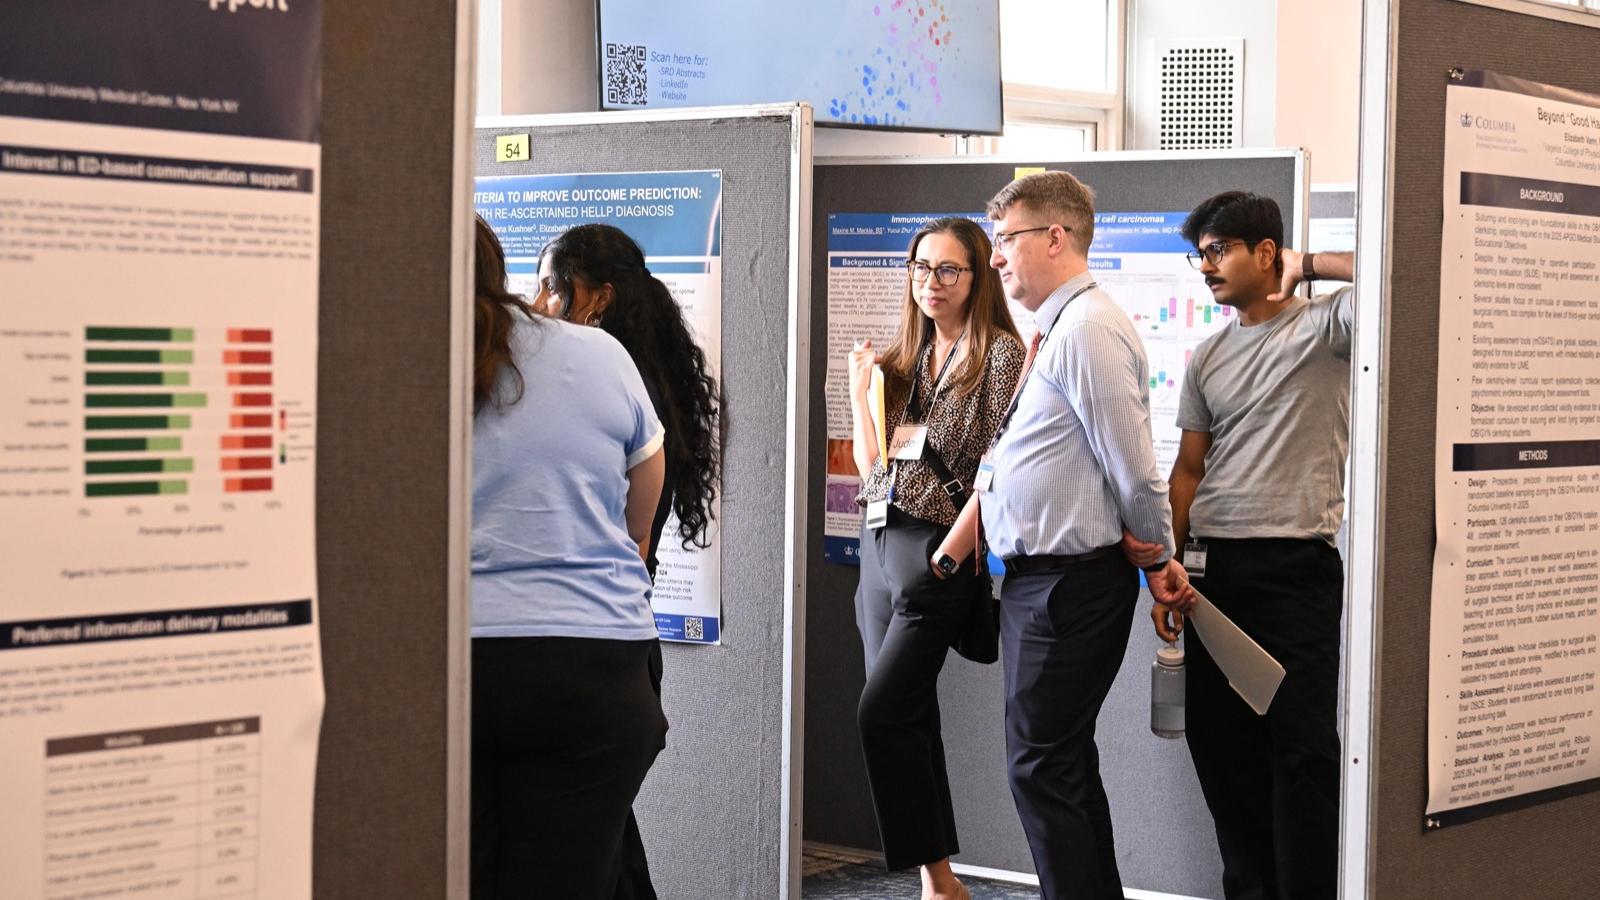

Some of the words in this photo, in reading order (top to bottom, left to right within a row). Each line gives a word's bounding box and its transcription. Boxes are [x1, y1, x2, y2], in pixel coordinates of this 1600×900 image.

[650, 51, 670, 63] Scan
[673, 53, 691, 64] here
[694, 55, 708, 66] for:
[658, 67, 674, 76] -SRD
[676, 68, 706, 78] Abstracts
[1538, 107, 1565, 126] Beyond
[1476, 116, 1516, 132] COLUMBIA
[505, 144, 520, 158] 54
[4, 152, 58, 171] Interest
[61, 156, 74, 171] in
[78, 156, 144, 177] ED-based
[146, 162, 246, 184] communication
[250, 169, 298, 188] support
[474, 192, 504, 204] ITERIA
[507, 192, 520, 203] TO
[523, 190, 568, 202] IMPROVE
[572, 188, 626, 201] OUTCOME
[630, 187, 702, 200] PREDICTION:
[1520, 188, 1564, 203] BACKGROUND
[495, 207, 578, 219] RE-ASCERTAINED
[582, 206, 613, 218] HELLP
[616, 205, 674, 217] DIAGNOSIS
[1118, 216, 1165, 224] carcinomas
[540, 224, 568, 233] Elizabeth
[843, 258, 880, 267] Background
[1519, 450, 1548, 460] METHODS
[1468, 478, 1487, 488] Design:
[12, 621, 80, 644] Preferred
[84, 616, 164, 640] information
[166, 613, 218, 634] delivery
[222, 608, 288, 628] modalities
[1462, 647, 1488, 658] Procedural
[1460, 690, 1473, 699] Skills
[1475, 685, 1504, 696] Assessment:
[1457, 727, 1482, 739] Outcomes:
